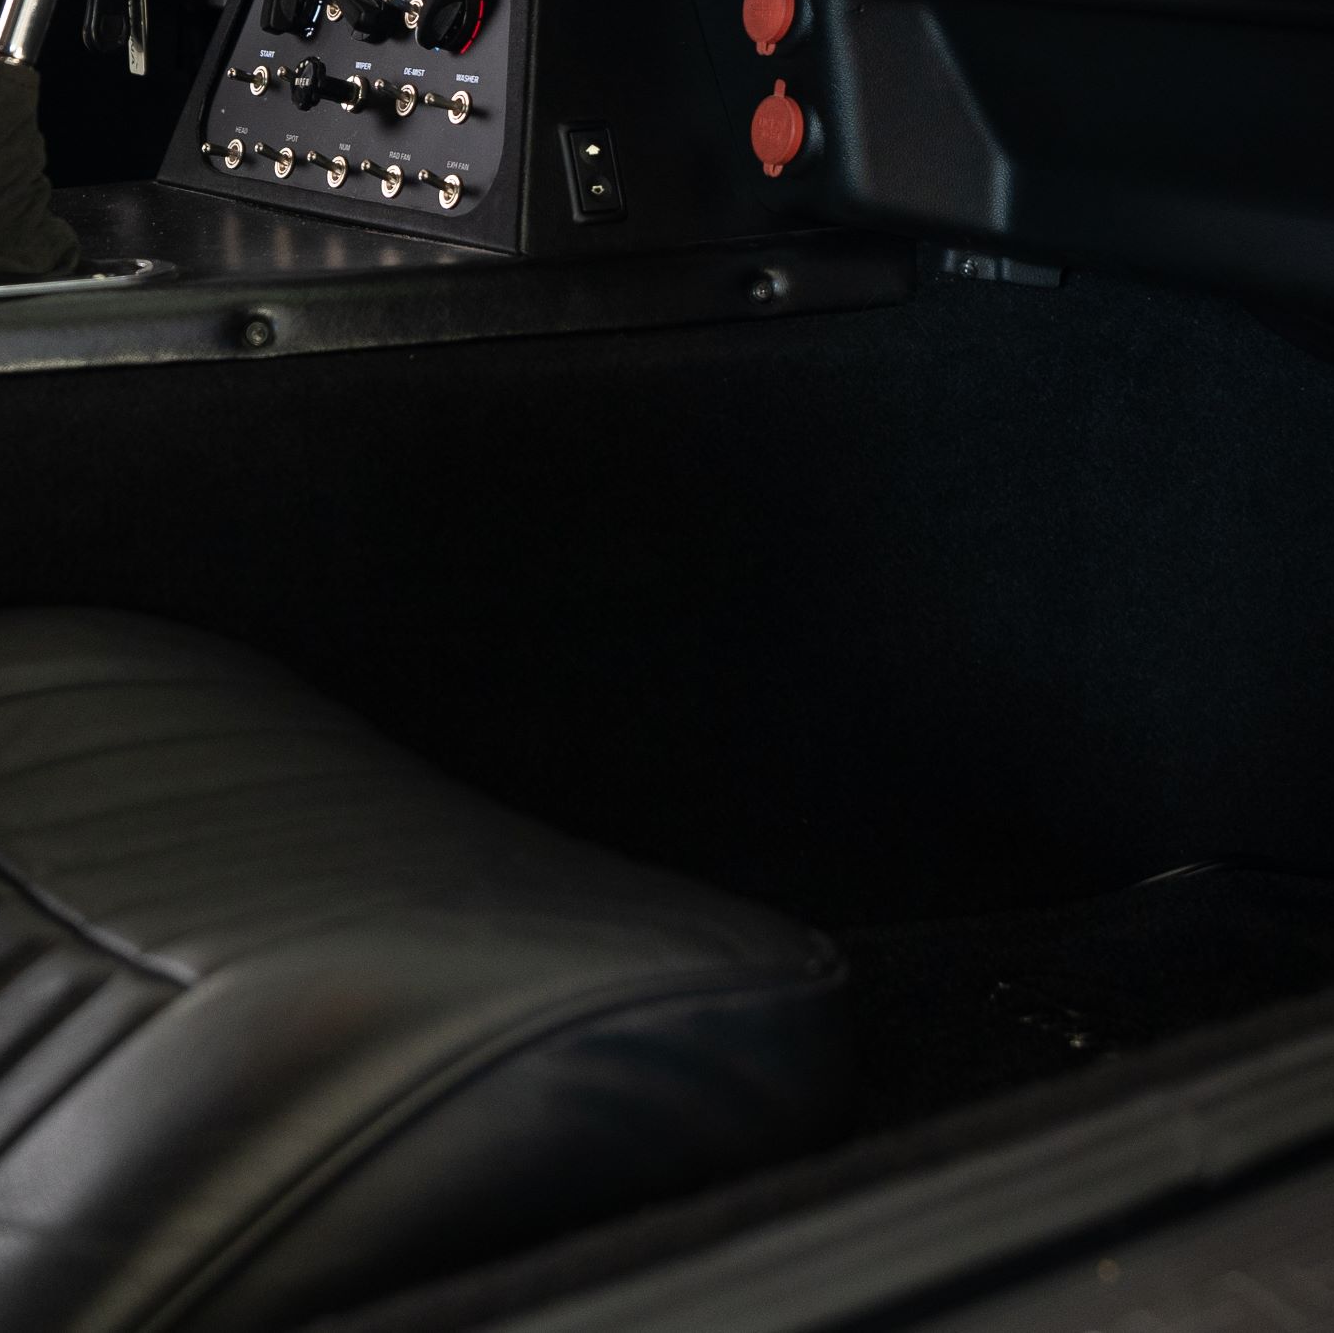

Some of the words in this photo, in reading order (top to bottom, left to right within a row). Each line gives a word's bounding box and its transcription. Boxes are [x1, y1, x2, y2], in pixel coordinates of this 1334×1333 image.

[259, 49, 276, 58] START
[355, 61, 372, 70] WIPER
[403, 67, 426, 77] DE-MIST
[455, 73, 480, 84] WASHER
[235, 126, 249, 135] HEAD
[285, 134, 299, 143] SPOT
[389, 151, 400, 160] RAD
[401, 153, 412, 162] FAN
[446, 160, 458, 169] EXH
[459, 162, 470, 171] FAN
